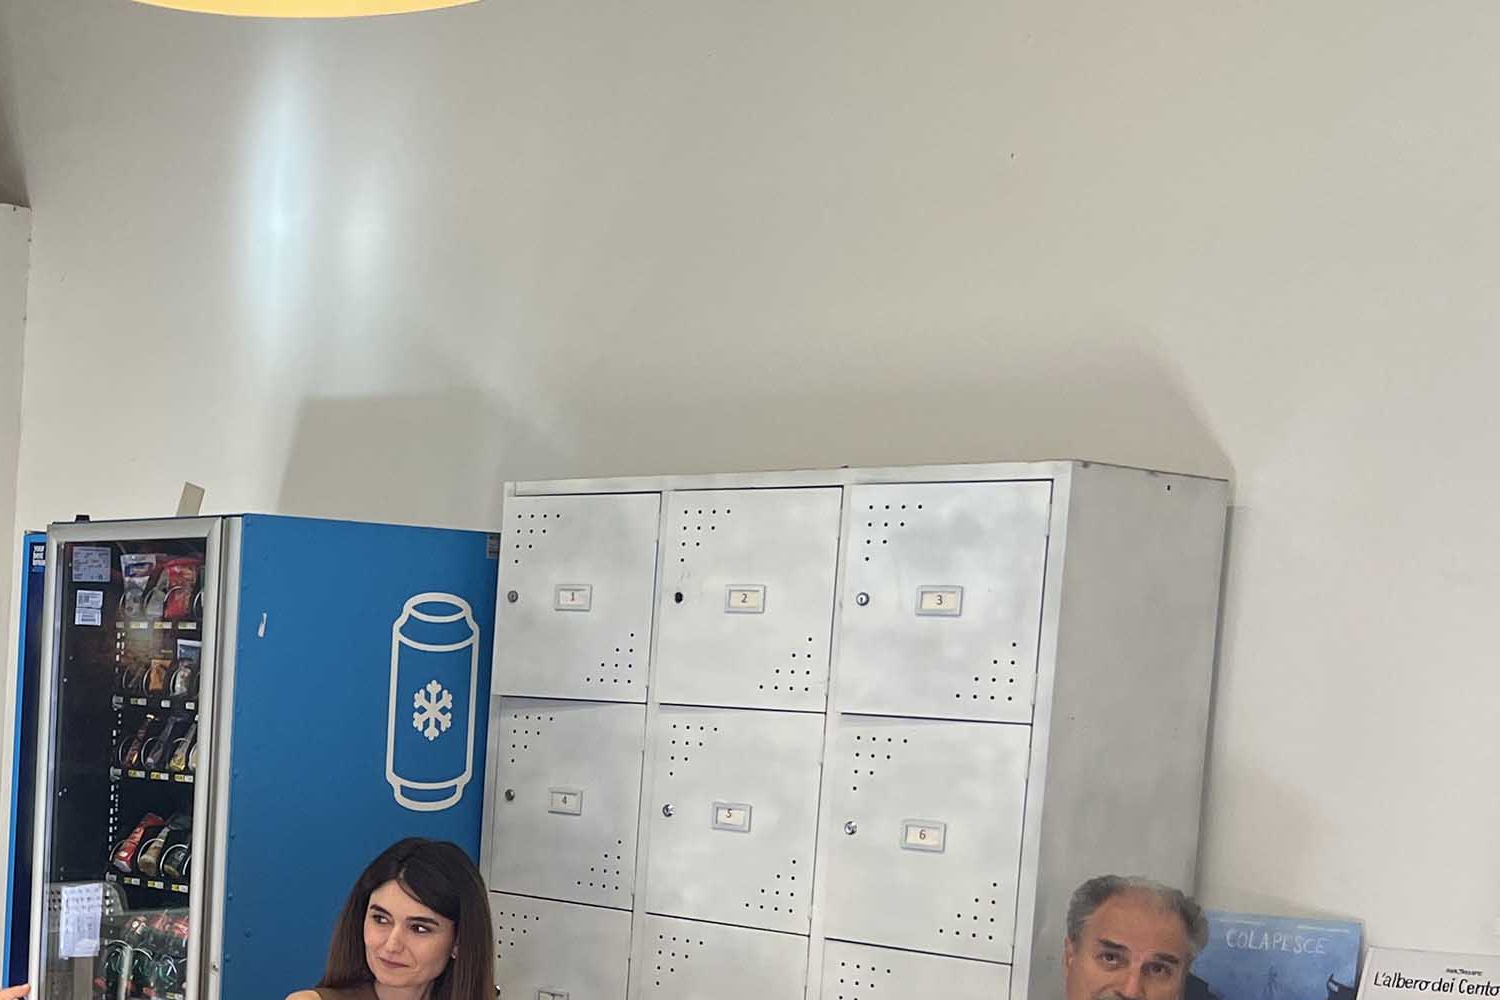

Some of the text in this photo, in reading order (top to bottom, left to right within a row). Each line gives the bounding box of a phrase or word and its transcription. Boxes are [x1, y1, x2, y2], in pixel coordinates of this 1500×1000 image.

[741, 593, 748, 604] 2
[936, 594, 943, 606] 3
[726, 808, 732, 819] 5
[919, 829, 926, 841] 6
[1226, 928, 1330, 955] COLAPESCE
[1373, 971, 1431, 992] L'albero
[1431, 977, 1456, 993] dei
[1458, 978, 1500, 997] Cento
